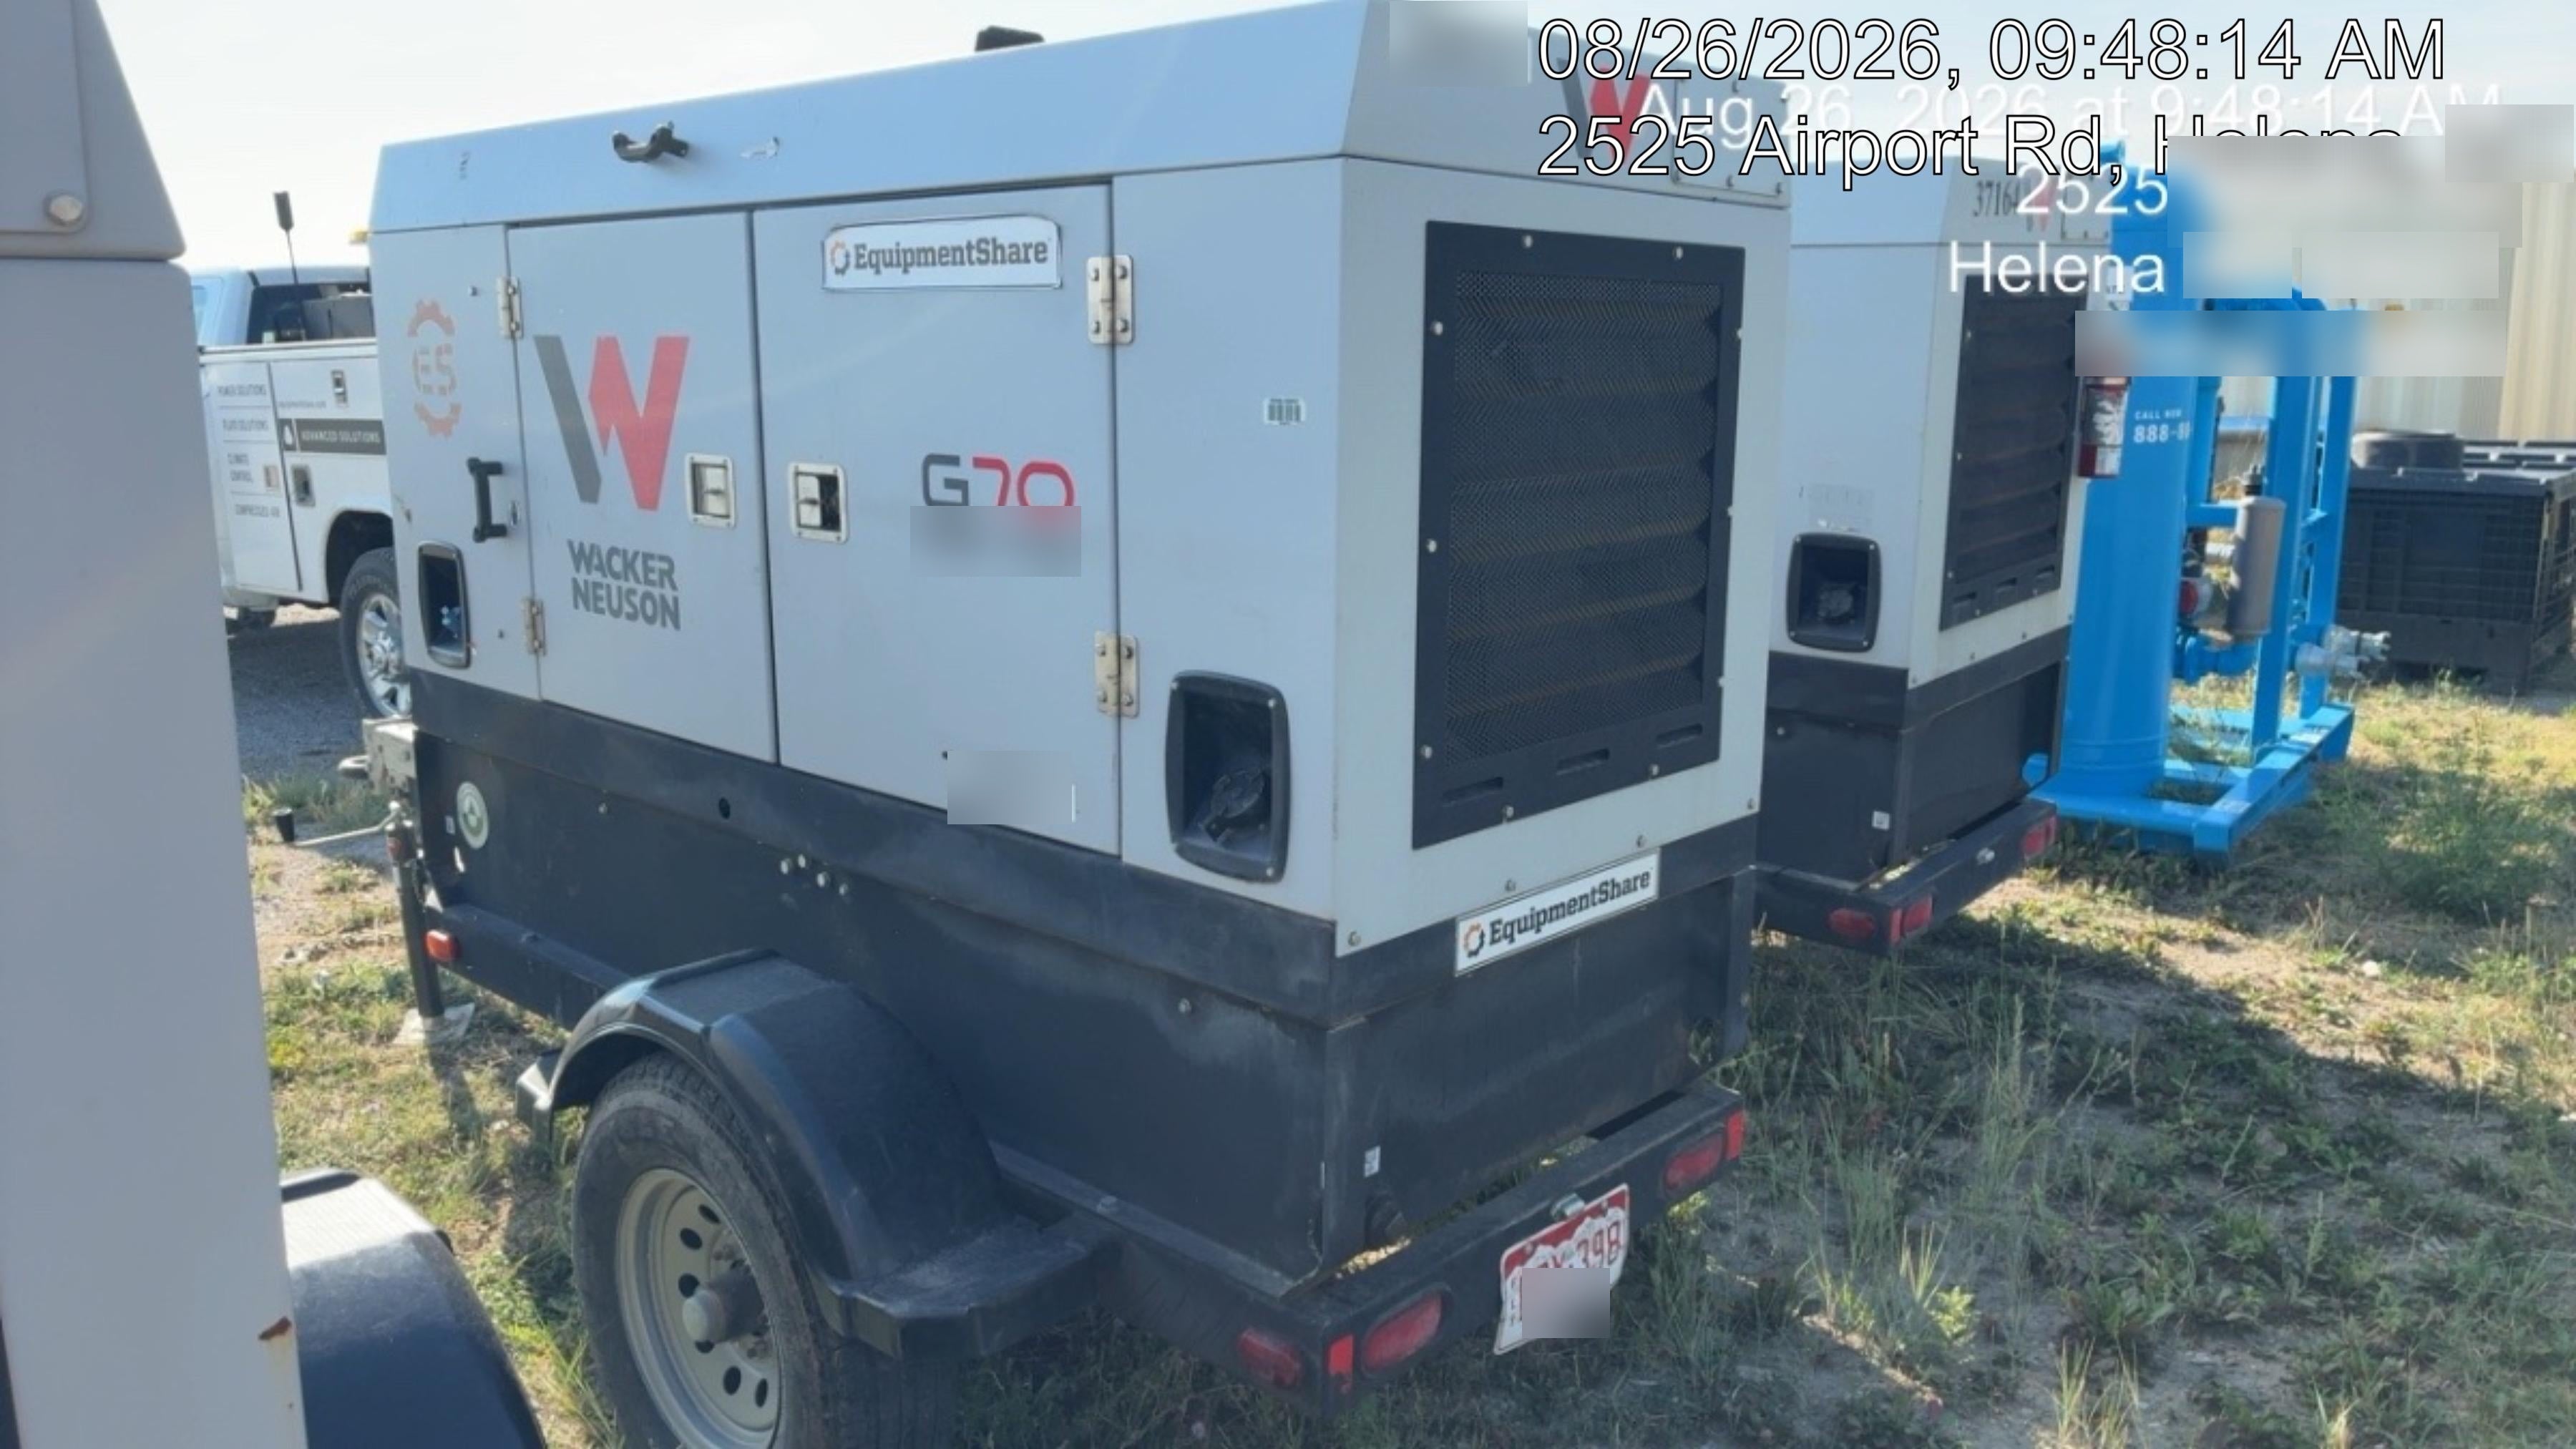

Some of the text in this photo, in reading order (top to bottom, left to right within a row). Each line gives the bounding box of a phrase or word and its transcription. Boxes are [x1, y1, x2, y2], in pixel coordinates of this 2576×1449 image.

[854, 237, 1048, 275] EquipmentShare
[567, 539, 678, 591] WACKER
[571, 577, 681, 631] NEUSON
[1489, 869, 1650, 945] EquipmentShare
